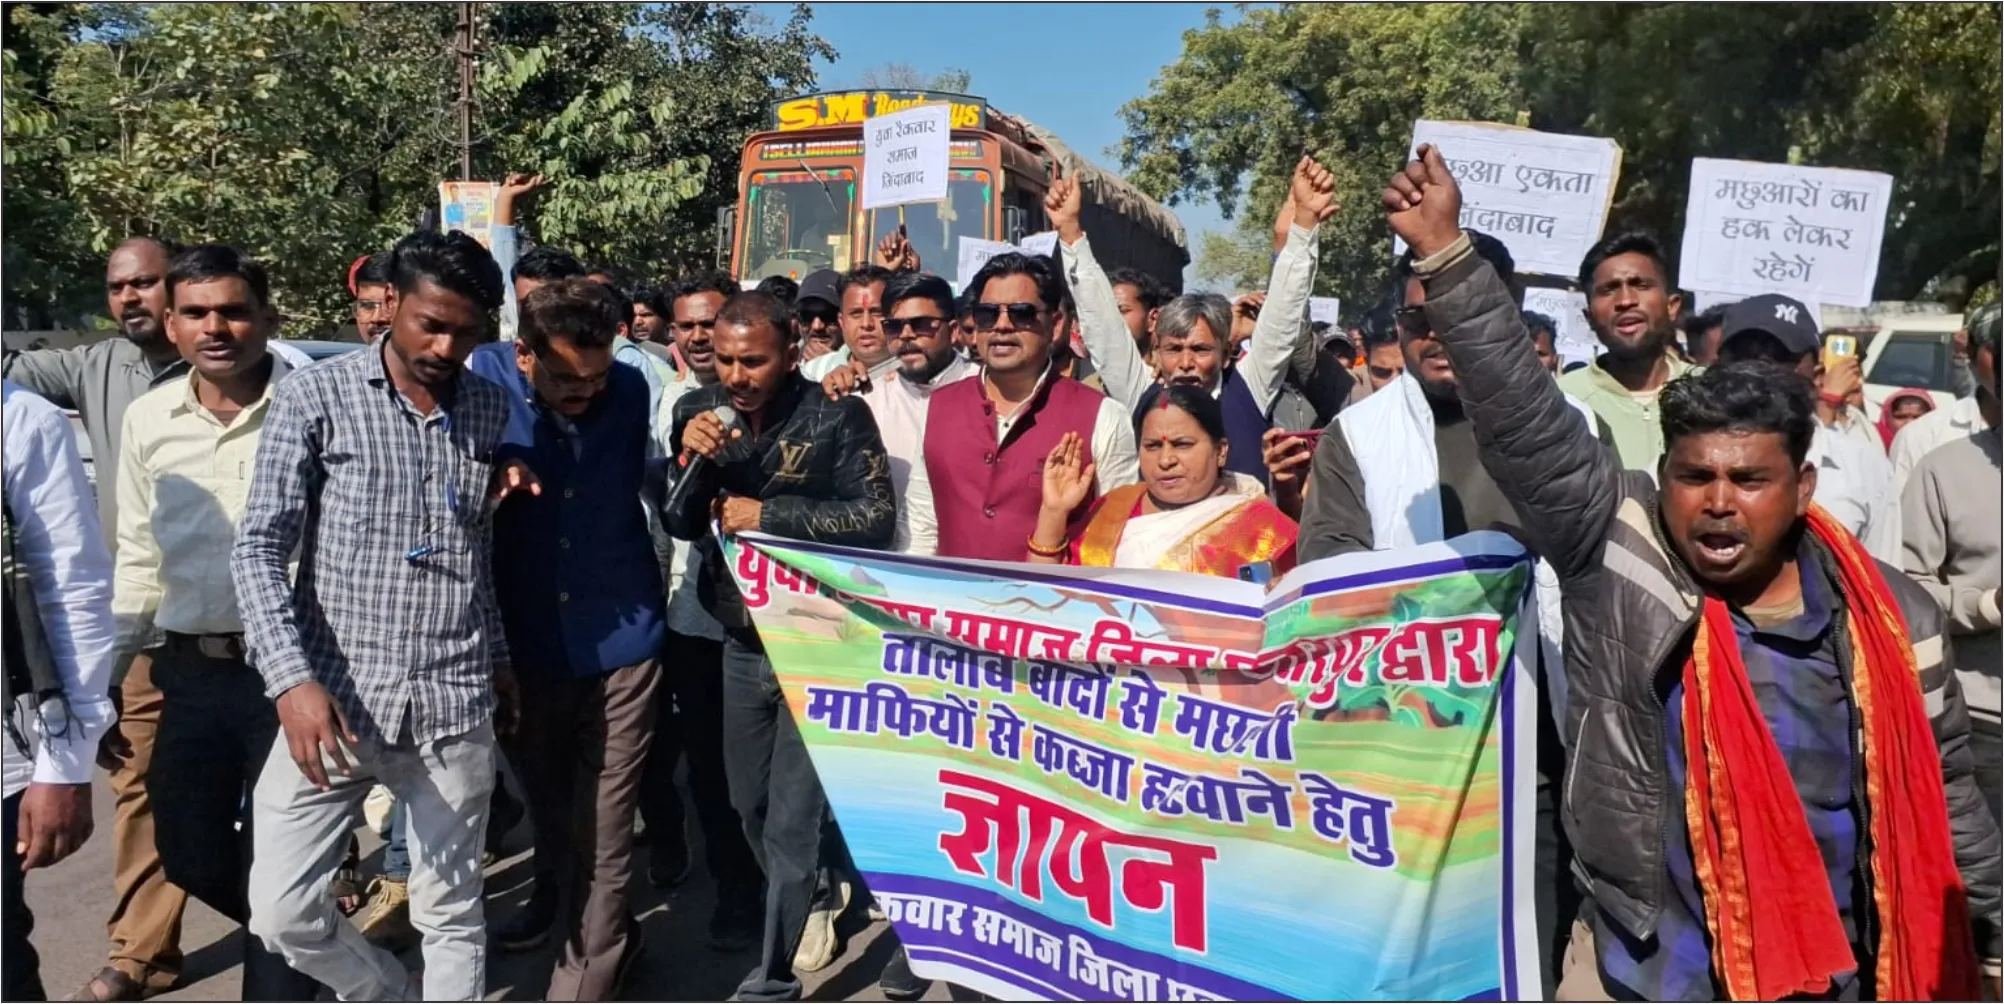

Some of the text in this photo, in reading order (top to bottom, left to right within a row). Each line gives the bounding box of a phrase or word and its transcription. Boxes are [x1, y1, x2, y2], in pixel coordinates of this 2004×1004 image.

[875, 120, 937, 148] युवा रैकवार
[887, 147, 917, 163] समाज
[1515, 164, 1595, 194] एकता
[1716, 178, 1871, 212] मछुआरों का
[1721, 215, 1853, 250] हक लेकर
[1382, 619, 1501, 686] द्वारा
[881, 633, 1017, 693] तालाब
[1120, 668, 1167, 734] से
[808, 683, 978, 748] माफियों
[986, 703, 1026, 759] से
[1033, 725, 1134, 801] कब्जा
[1300, 774, 1394, 867] हेतु
[938, 769, 1217, 953] ज्ञापन
[972, 906, 1063, 970] समाज
[1068, 934, 1160, 1001] जिला
